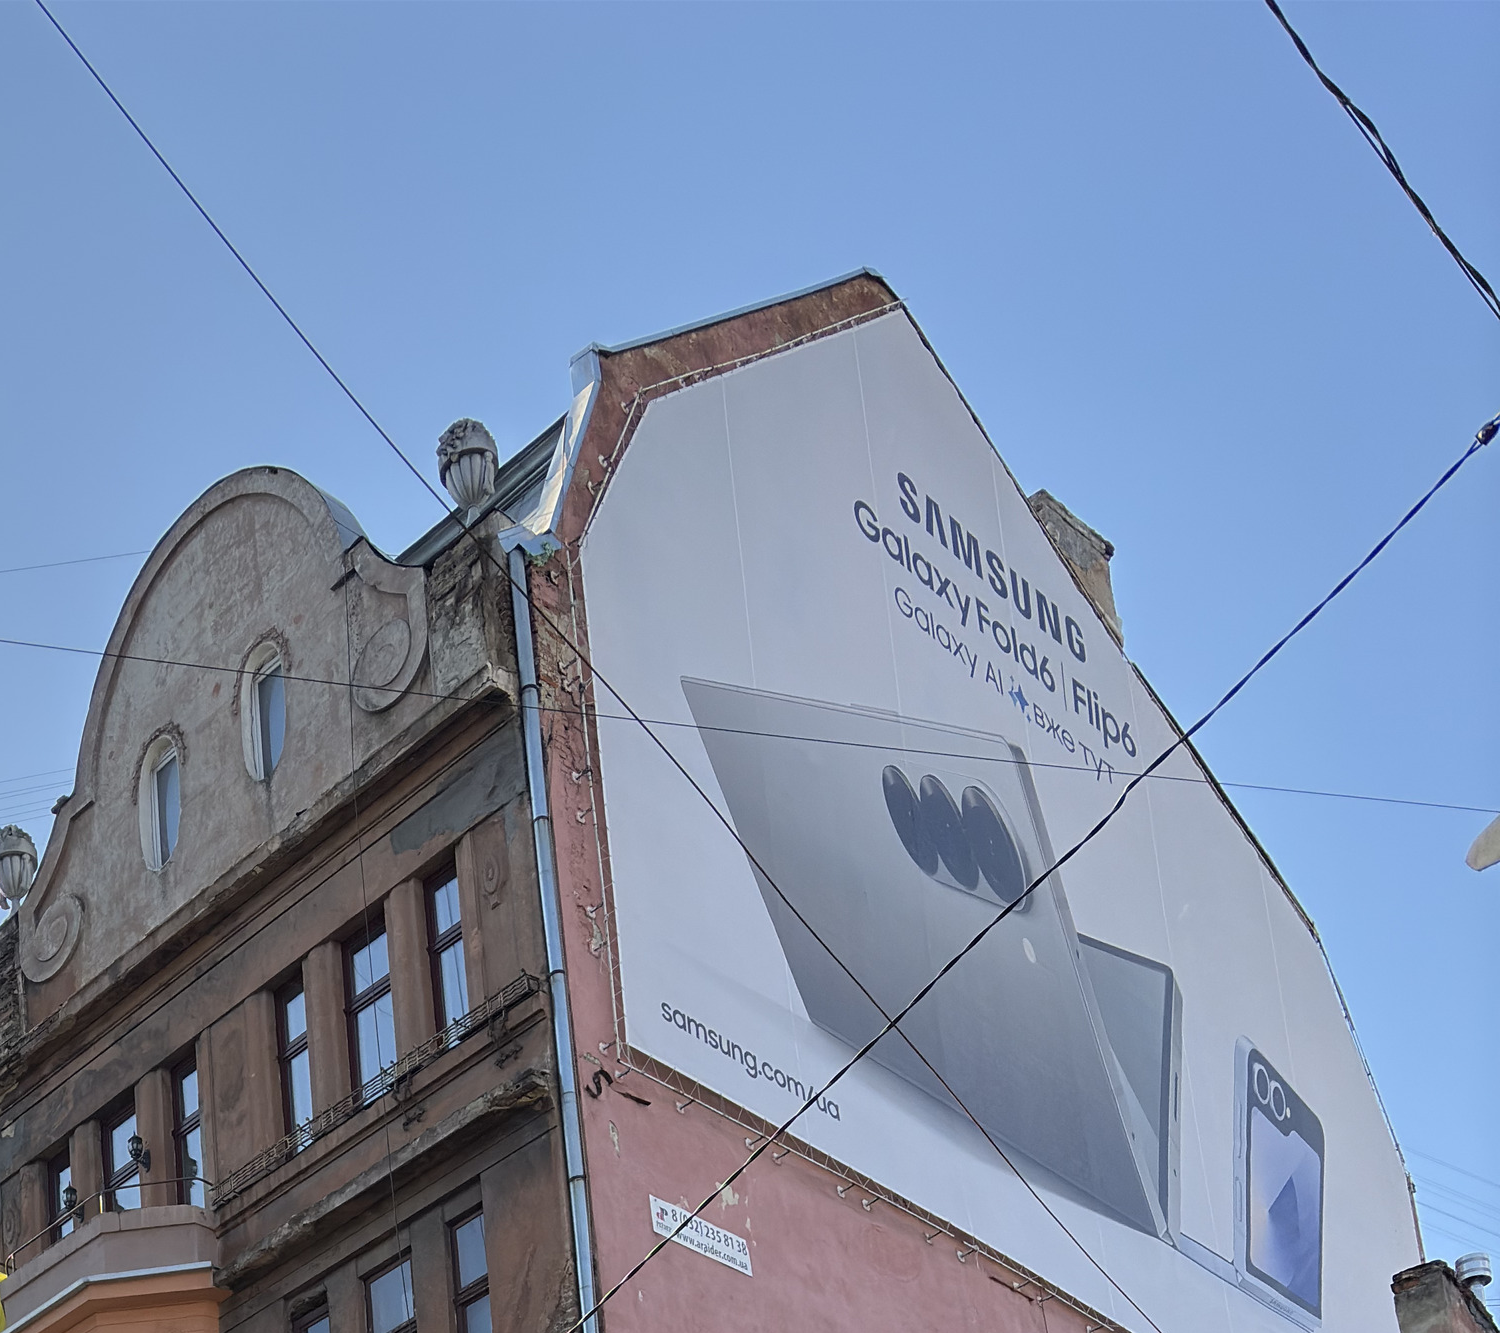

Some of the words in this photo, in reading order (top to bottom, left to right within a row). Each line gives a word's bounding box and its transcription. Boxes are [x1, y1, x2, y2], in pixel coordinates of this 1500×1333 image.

[897, 471, 1087, 663] SAMSUNG
[853, 499, 971, 628] Galaxy
[975, 596, 1056, 693] Fold6
[1071, 677, 1137, 758] Flip6
[894, 586, 978, 679] Galaxy
[986, 660, 1004, 696] AI
[1033, 702, 1076, 754] вже
[1078, 740, 1114, 785] тут
[660, 1001, 841, 1122] samsung.com/ua
[671, 1208, 678, 1222] 8
[704, 1224, 722, 1243] 235
